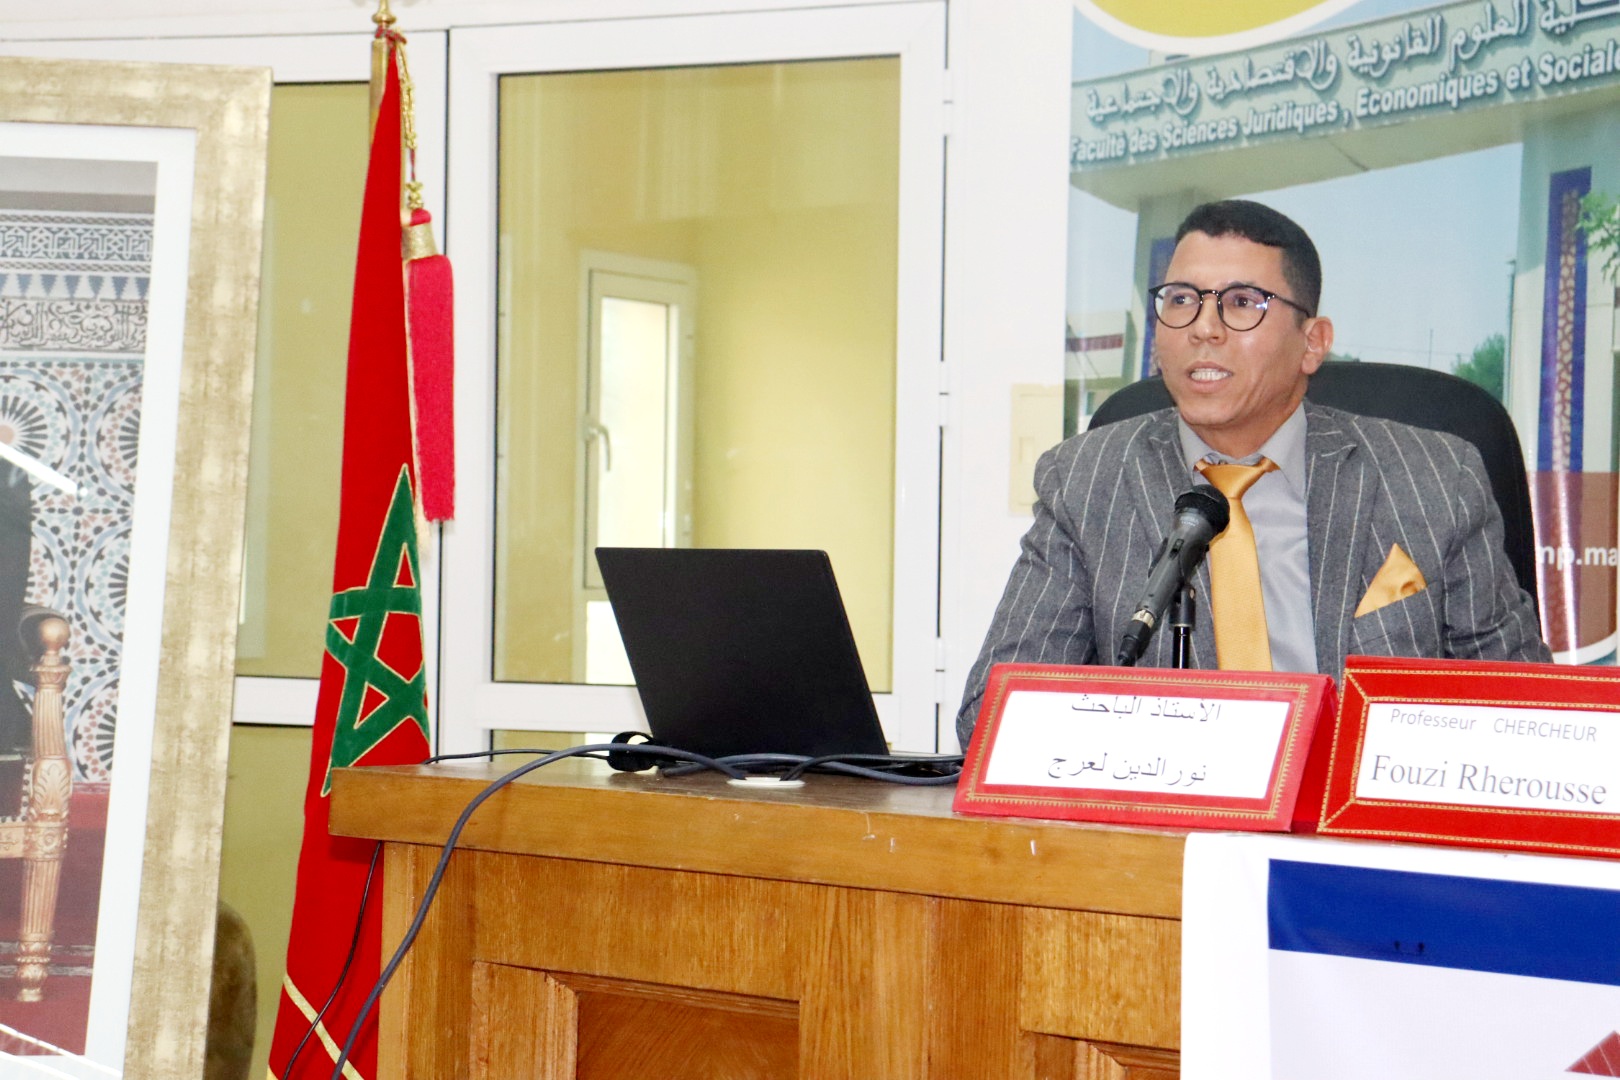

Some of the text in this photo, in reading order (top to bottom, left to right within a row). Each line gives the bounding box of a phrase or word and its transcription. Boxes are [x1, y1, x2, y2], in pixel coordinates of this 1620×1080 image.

[1449, 0, 1528, 71] العلوم
[1540, 0, 1620, 34] لية
[1348, 14, 1442, 77] القانونية
[1129, 127, 1157, 154] des
[1162, 117, 1238, 149] Sciences
[1506, 59, 1531, 90] et
[1072, 694, 1142, 719] الباحث
[1390, 708, 1598, 742] Professeur CHERCHEUR
[1048, 752, 1108, 779] لعرج
[1371, 754, 1607, 805] Fouzi Rherousse
